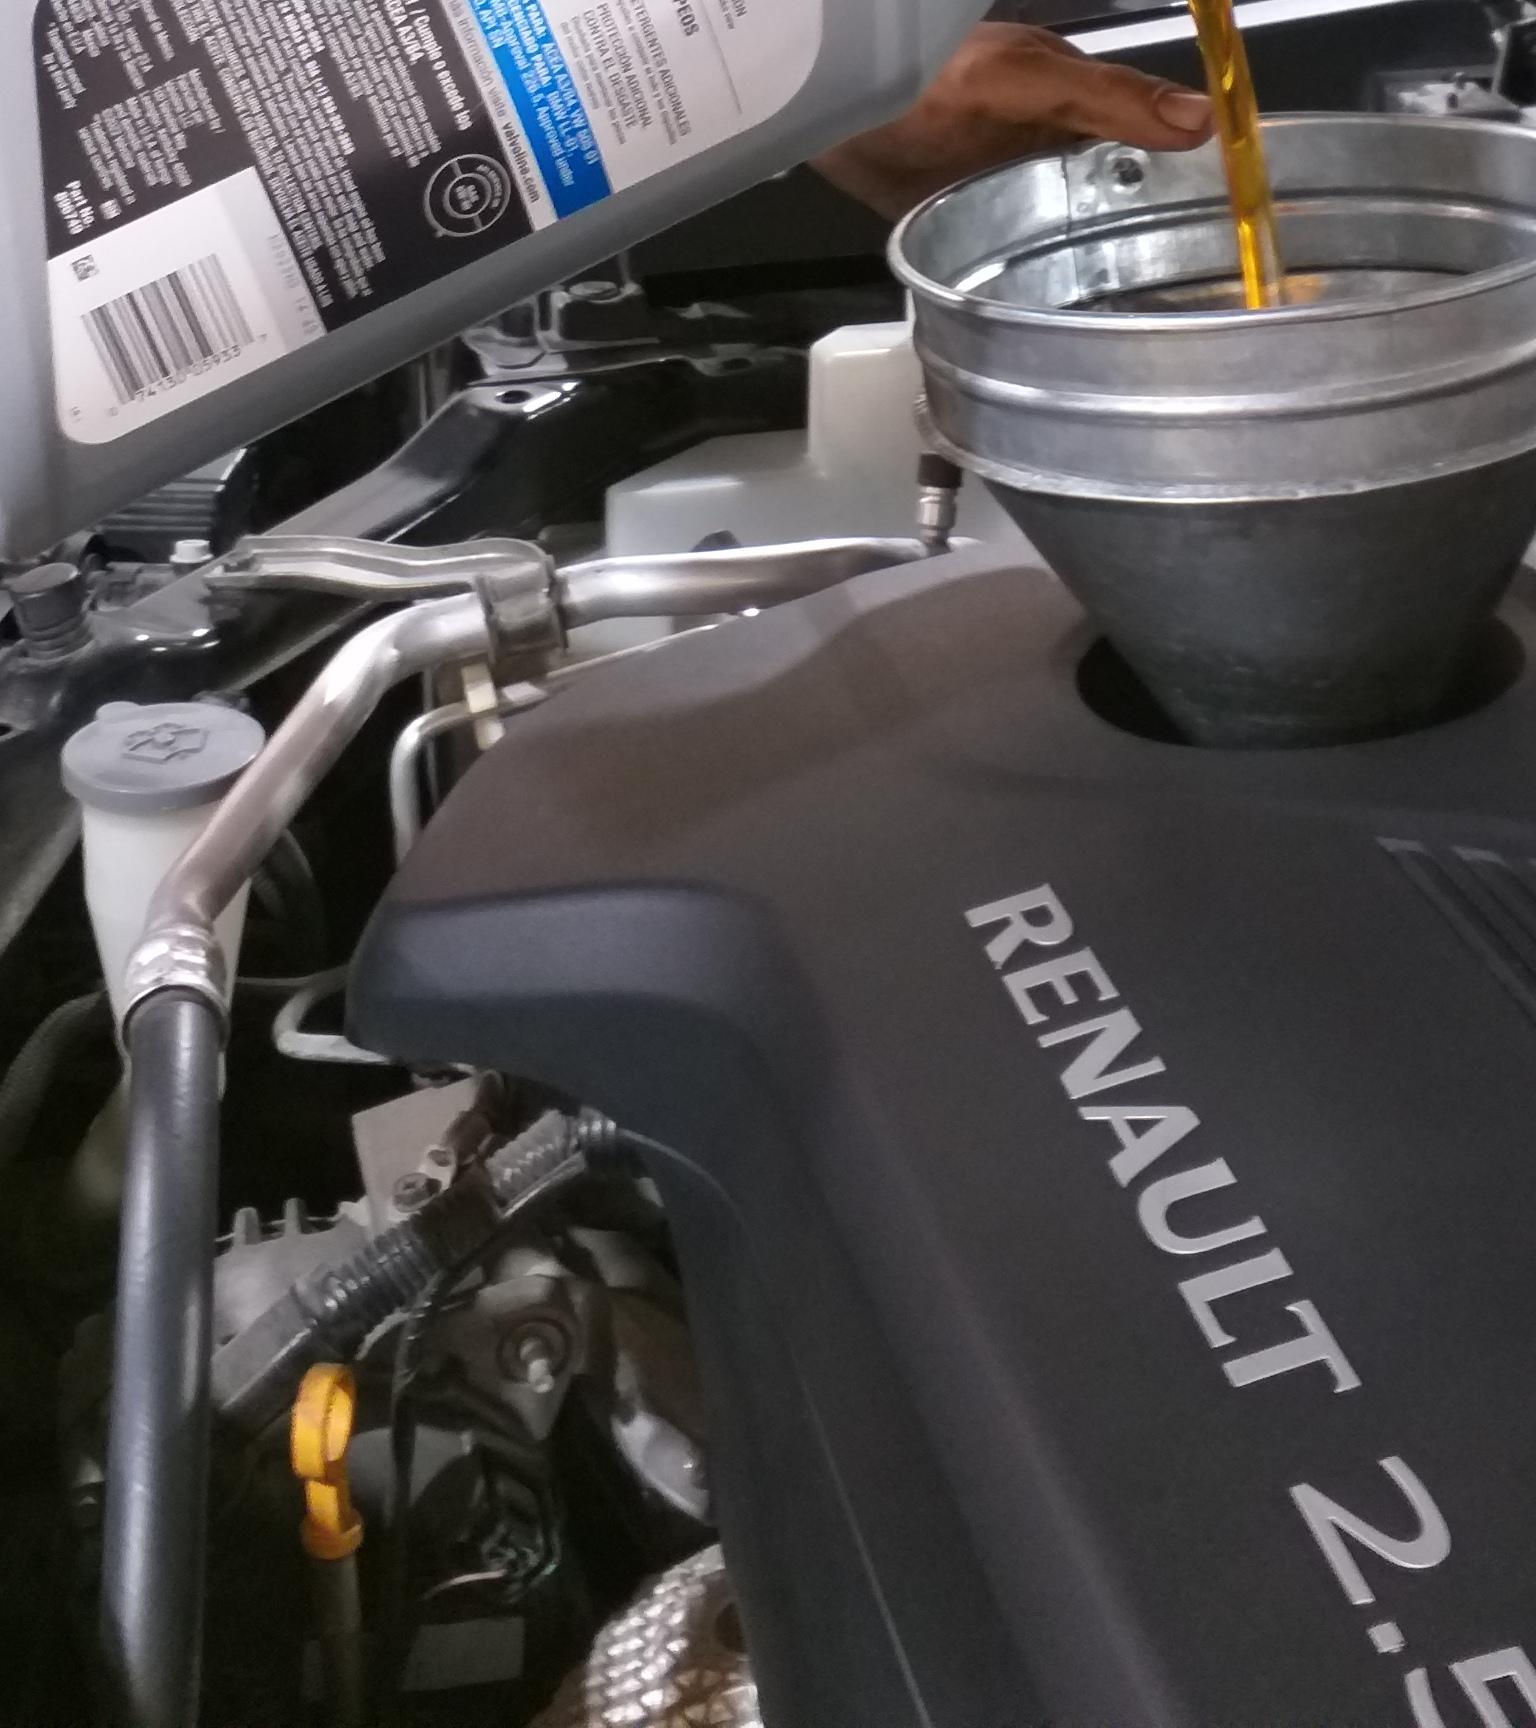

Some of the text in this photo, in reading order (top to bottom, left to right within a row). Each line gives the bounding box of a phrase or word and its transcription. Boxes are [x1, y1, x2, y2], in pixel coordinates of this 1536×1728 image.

[410, 14, 444, 62] Cumple
[478, 7, 497, 30] API
[430, 58, 449, 72] o
[540, 40, 563, 74] ACEA
[568, 107, 586, 129] VW
[581, 8, 638, 129] CONTRA EL DESGASTE
[595, 2, 655, 129] PROTECCIÓN ADICIONAL
[434, 68, 467, 113] excede
[455, 17, 497, 87] información
[499, 120, 542, 203] valvoline.com
[545, 89, 567, 122] BMW
[656, 66, 693, 136] ADICIONALES
[453, 109, 475, 131] los
[65, 179, 88, 207] Part
[965, 883, 1362, 1395] RENAULT
